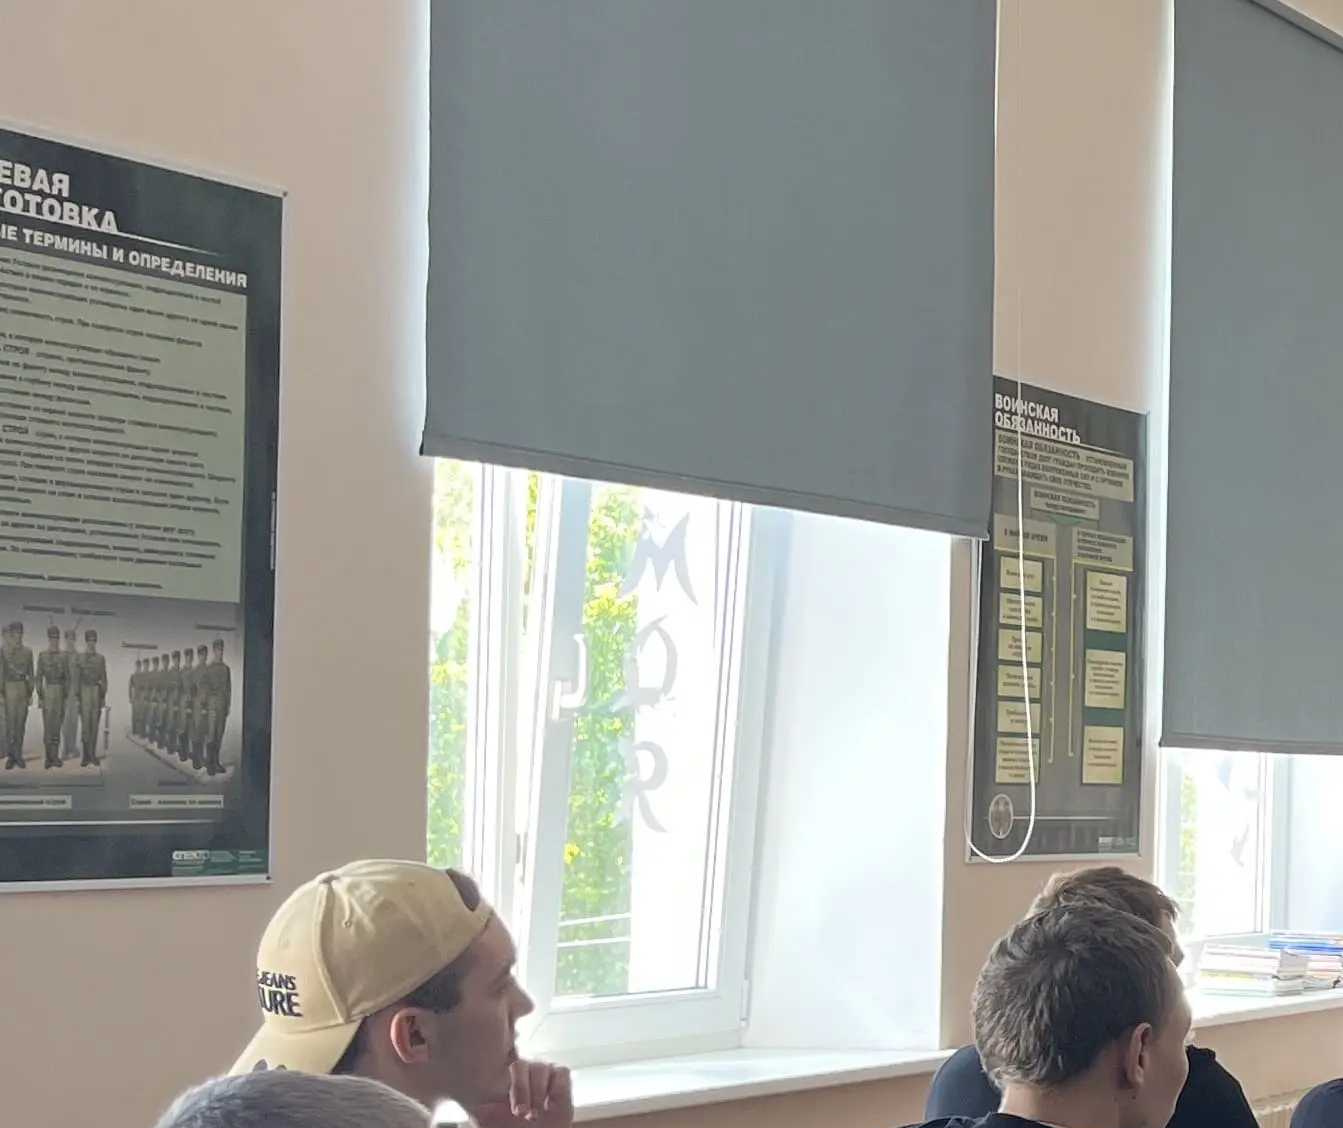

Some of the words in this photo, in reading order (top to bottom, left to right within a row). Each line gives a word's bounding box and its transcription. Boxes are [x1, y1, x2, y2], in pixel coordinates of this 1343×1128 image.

[0, 188, 119, 233] ОТОВКА
[22, 228, 108, 260] ТЕРМИНЫ
[113, 247, 124, 264] И
[129, 251, 248, 288] ОПРЕДЕЛЕНИЯ
[995, 393, 1058, 423] ВОИНСКАЯ
[995, 411, 1080, 444] ОБЯЗАННОСТЬ
